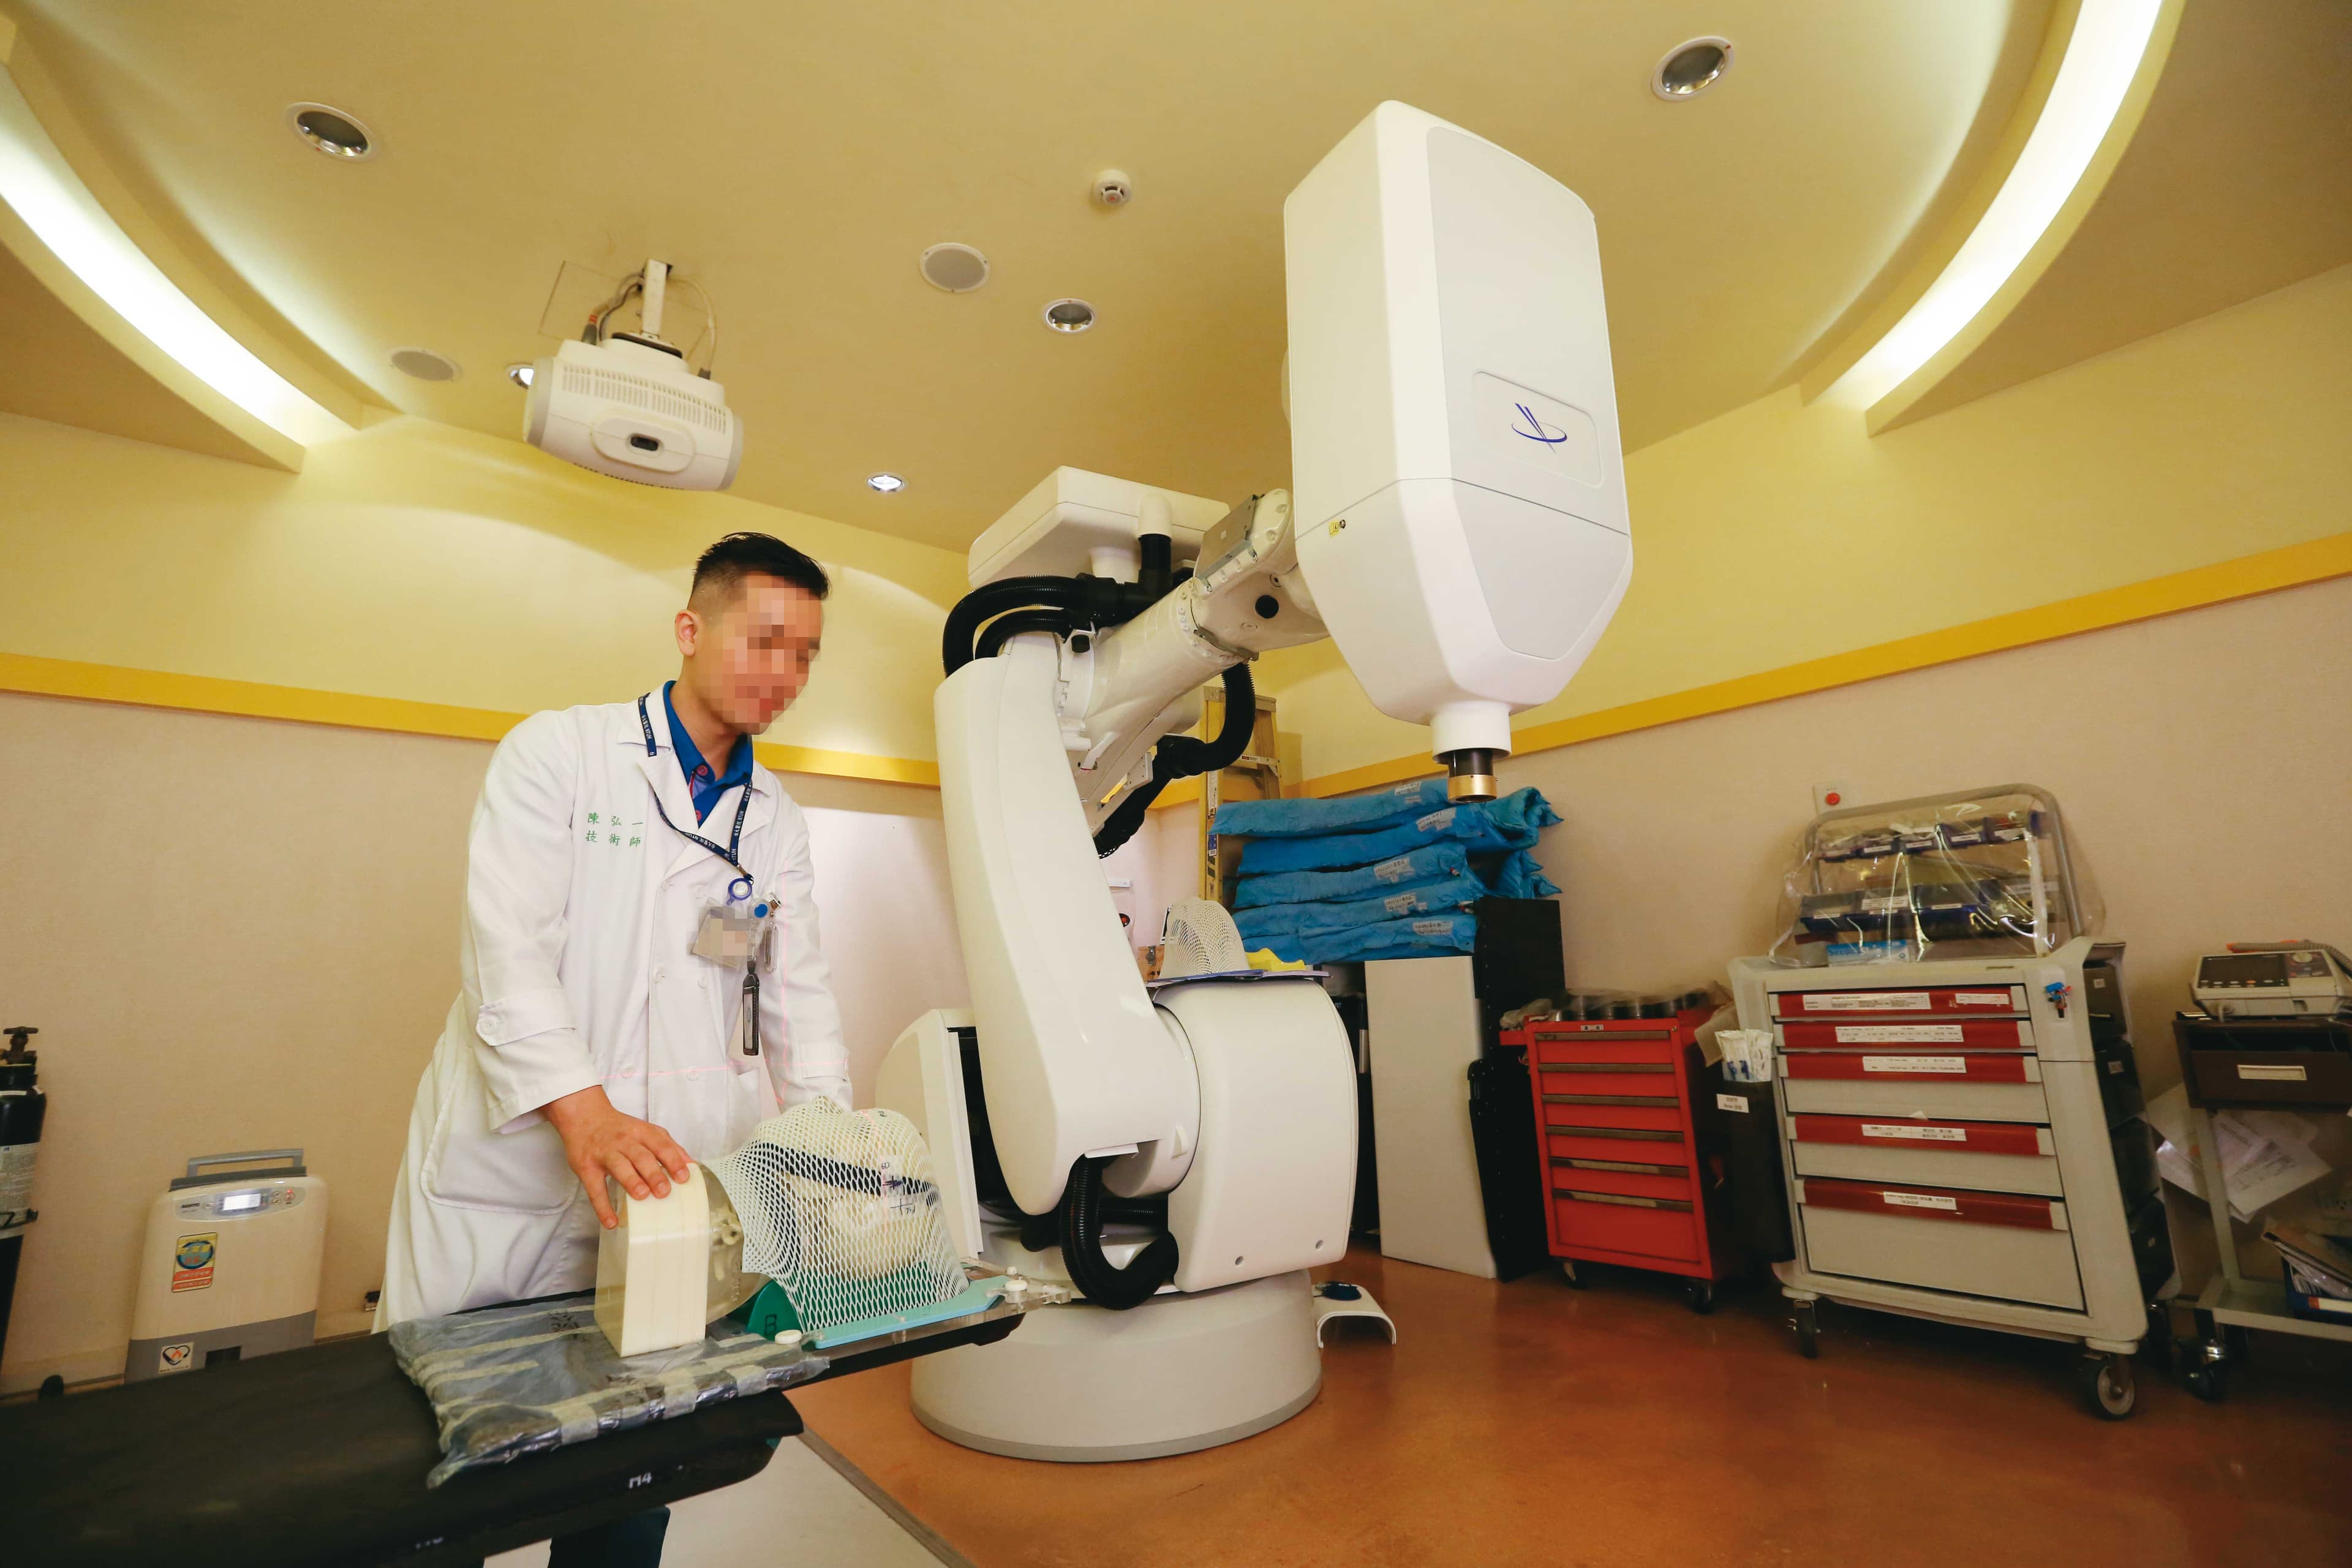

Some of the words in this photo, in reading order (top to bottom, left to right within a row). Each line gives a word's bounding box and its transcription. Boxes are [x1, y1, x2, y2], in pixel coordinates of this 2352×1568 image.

[587, 812, 644, 827] 陳弘一
[586, 829, 642, 848] 技術師
